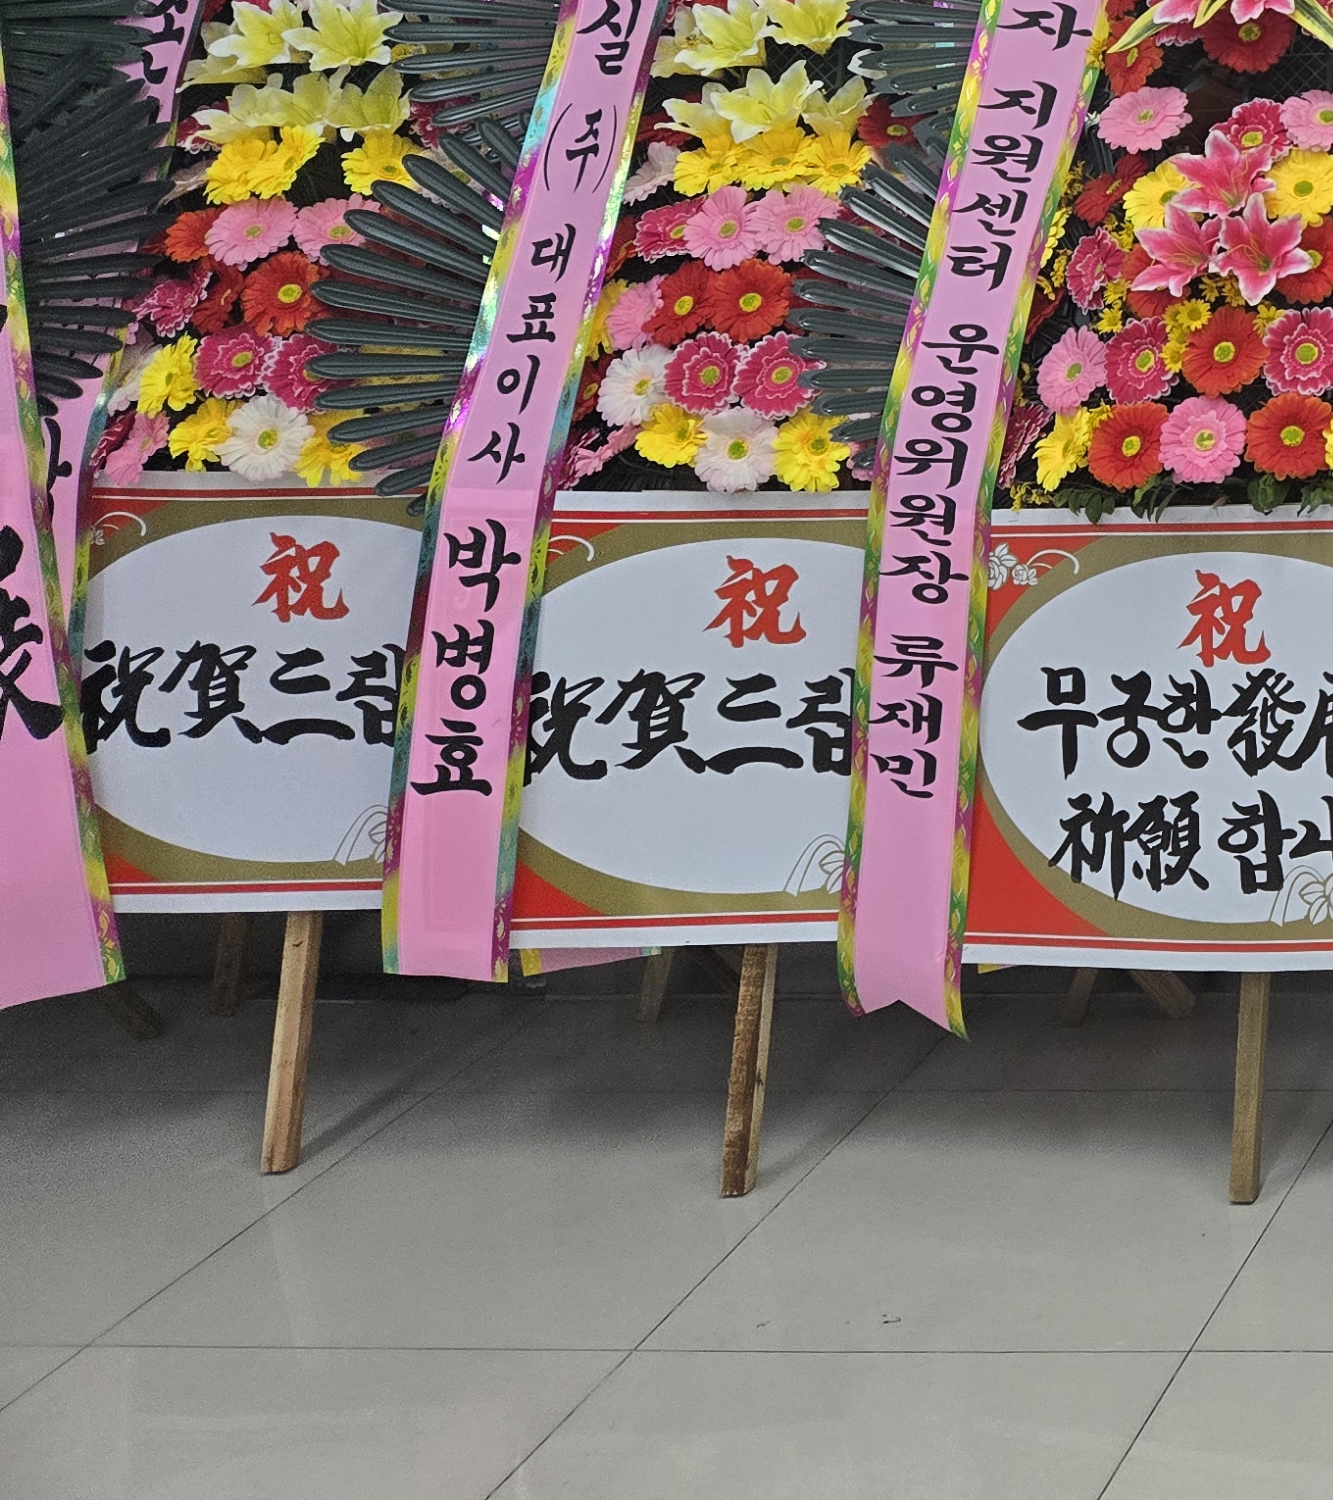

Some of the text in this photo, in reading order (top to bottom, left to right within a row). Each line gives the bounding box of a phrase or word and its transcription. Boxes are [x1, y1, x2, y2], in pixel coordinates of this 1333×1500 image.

[542, 105, 618, 195] (주)
[945, 79, 1059, 292] 지원센터
[468, 222, 576, 486] 대표이사
[878, 322, 1000, 606] 운영위원장
[252, 531, 350, 624] 祝
[702, 555, 807, 648] 祝
[1178, 569, 1272, 668] 祝
[409, 517, 523, 799] 박병효
[868, 633, 958, 801] 류재민
[1048, 788, 1210, 901] 祈願
